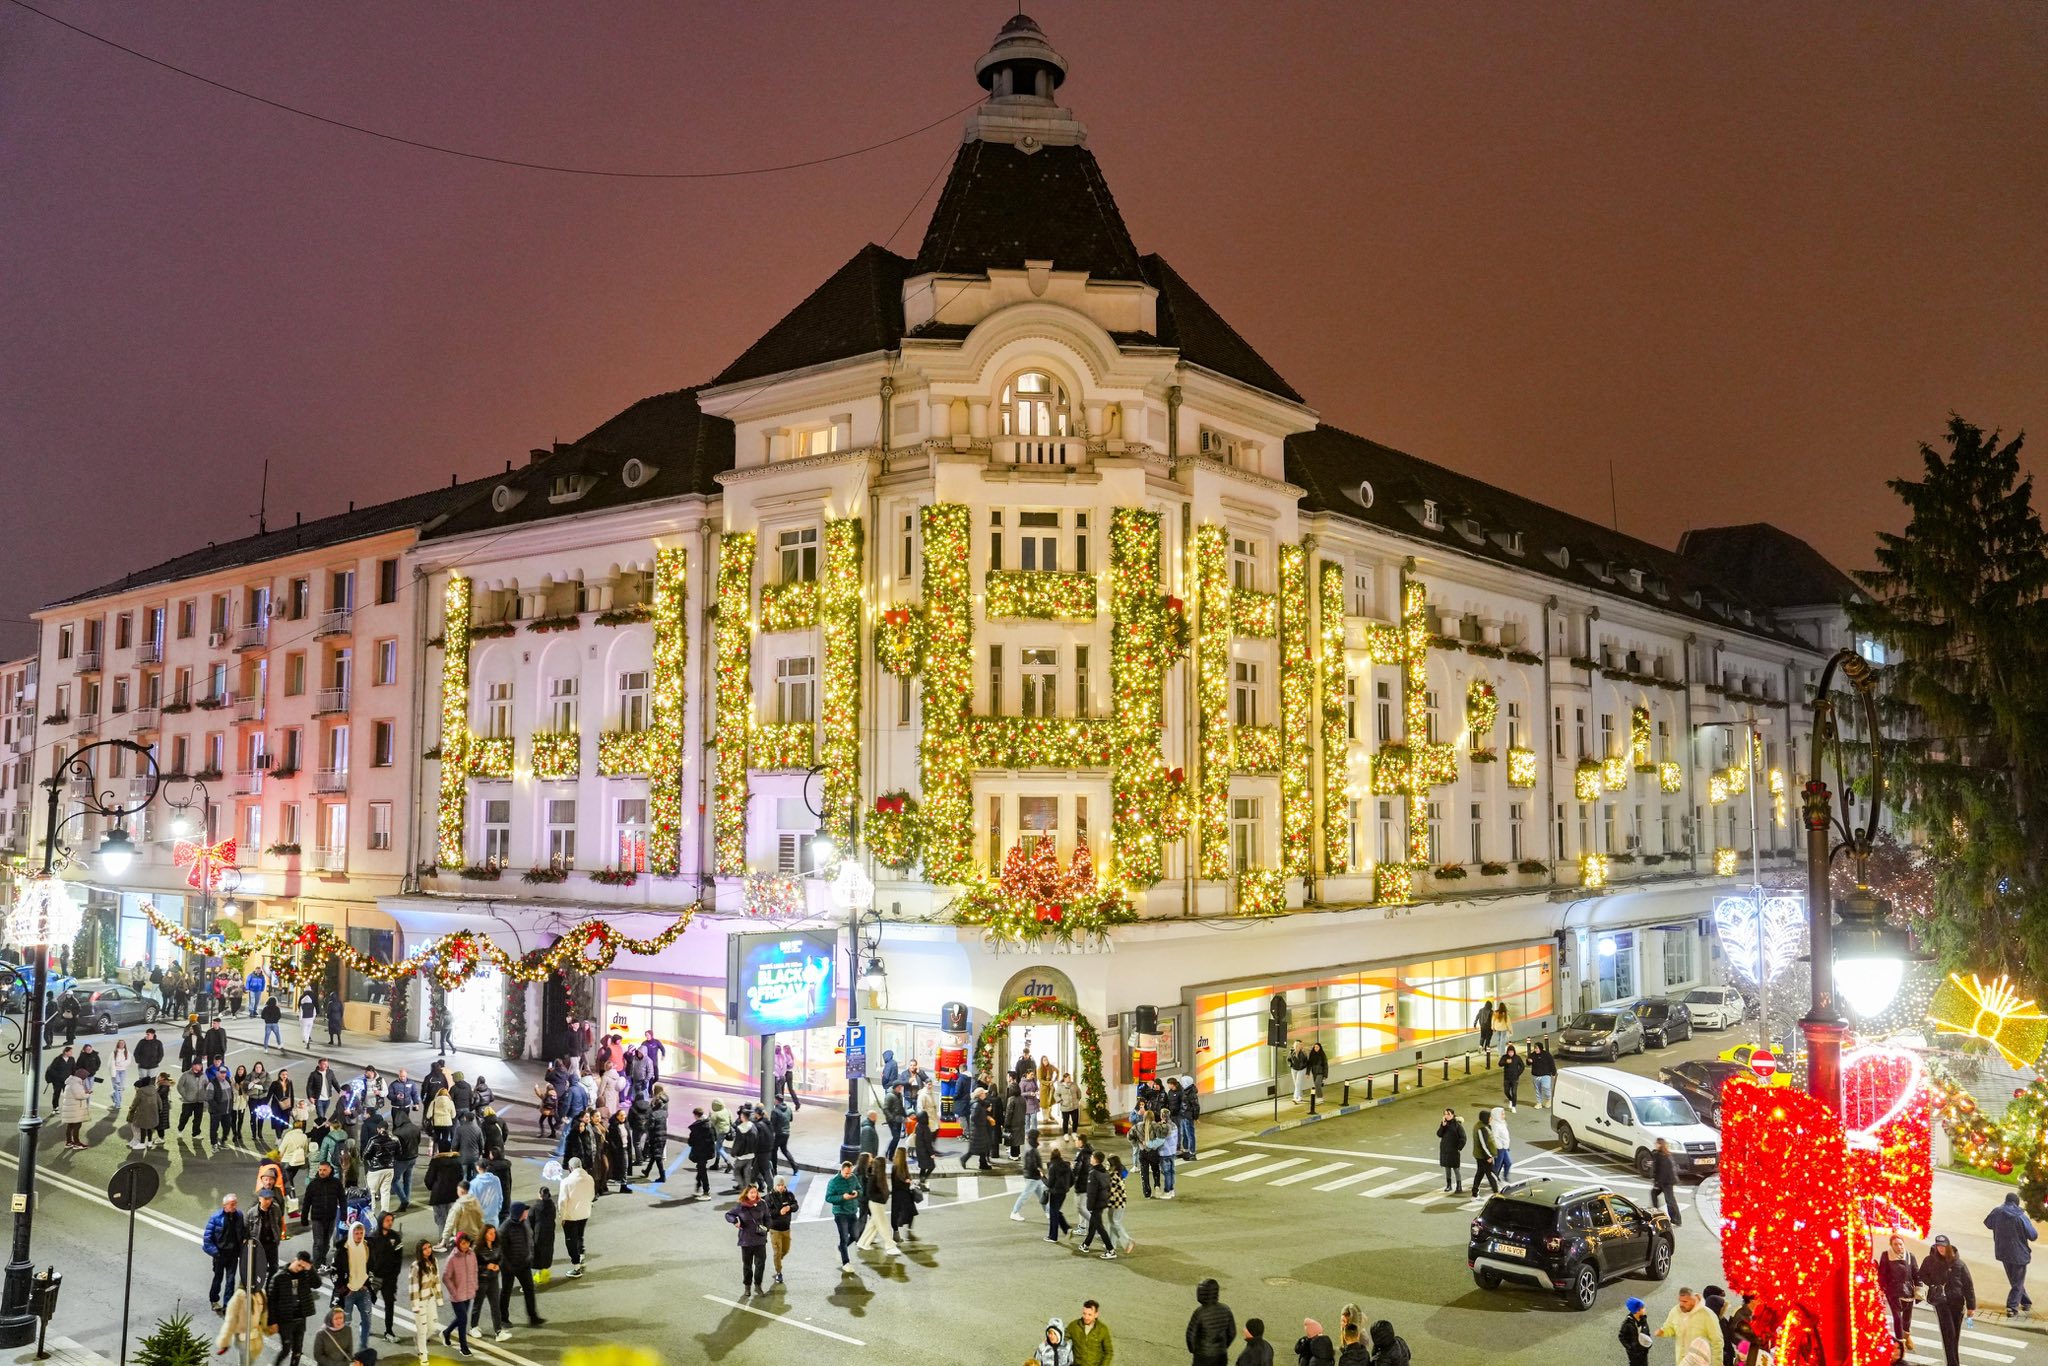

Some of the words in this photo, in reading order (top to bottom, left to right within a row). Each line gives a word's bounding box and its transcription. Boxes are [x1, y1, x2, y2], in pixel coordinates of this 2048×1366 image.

[758, 968, 803, 986] BLACK
[757, 983, 805, 1001] FRIDAY
[1024, 979, 1054, 996] dm
[612, 1012, 627, 1025] dm
[837, 1034, 846, 1048] d
[850, 1028, 862, 1046] P
[1197, 1036, 1209, 1048] dm
